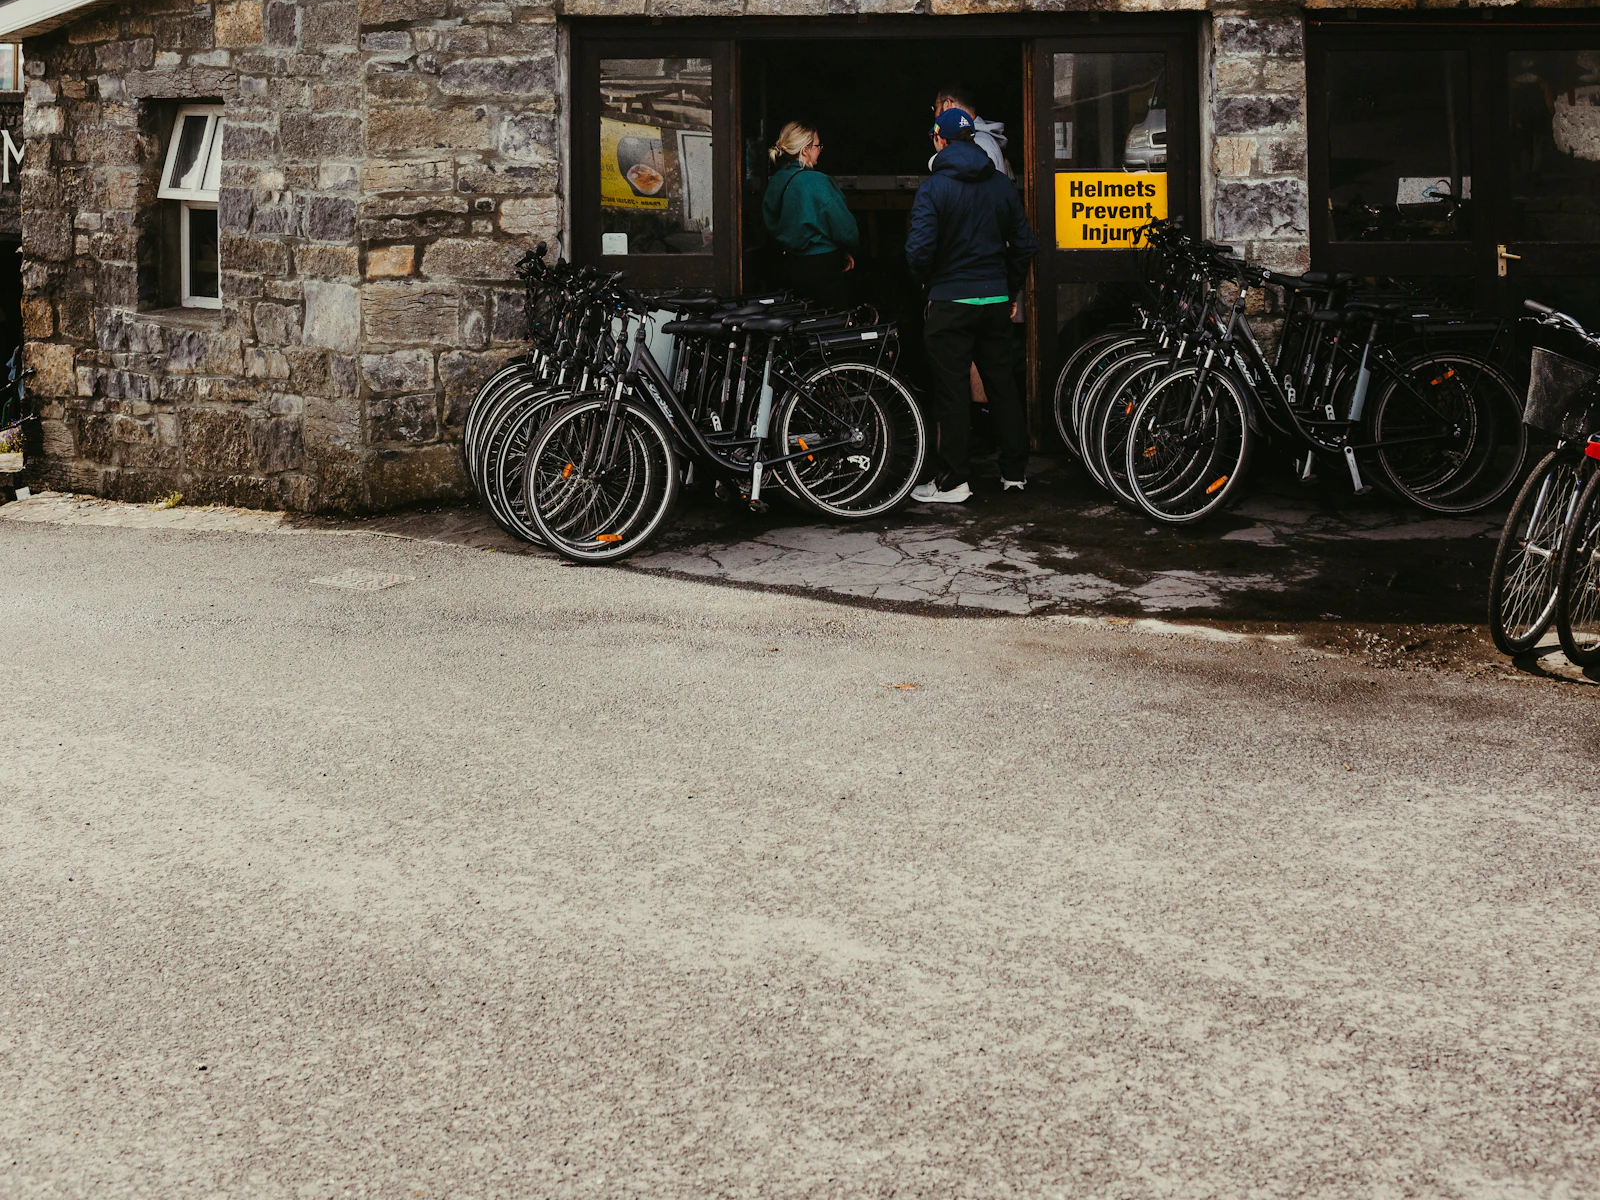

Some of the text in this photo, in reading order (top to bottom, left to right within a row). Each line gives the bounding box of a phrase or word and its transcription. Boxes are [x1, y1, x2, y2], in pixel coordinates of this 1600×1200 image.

[1070, 181, 1156, 197] Helmets
[1072, 202, 1152, 219] Prevent
[1082, 224, 1143, 244] Injury
